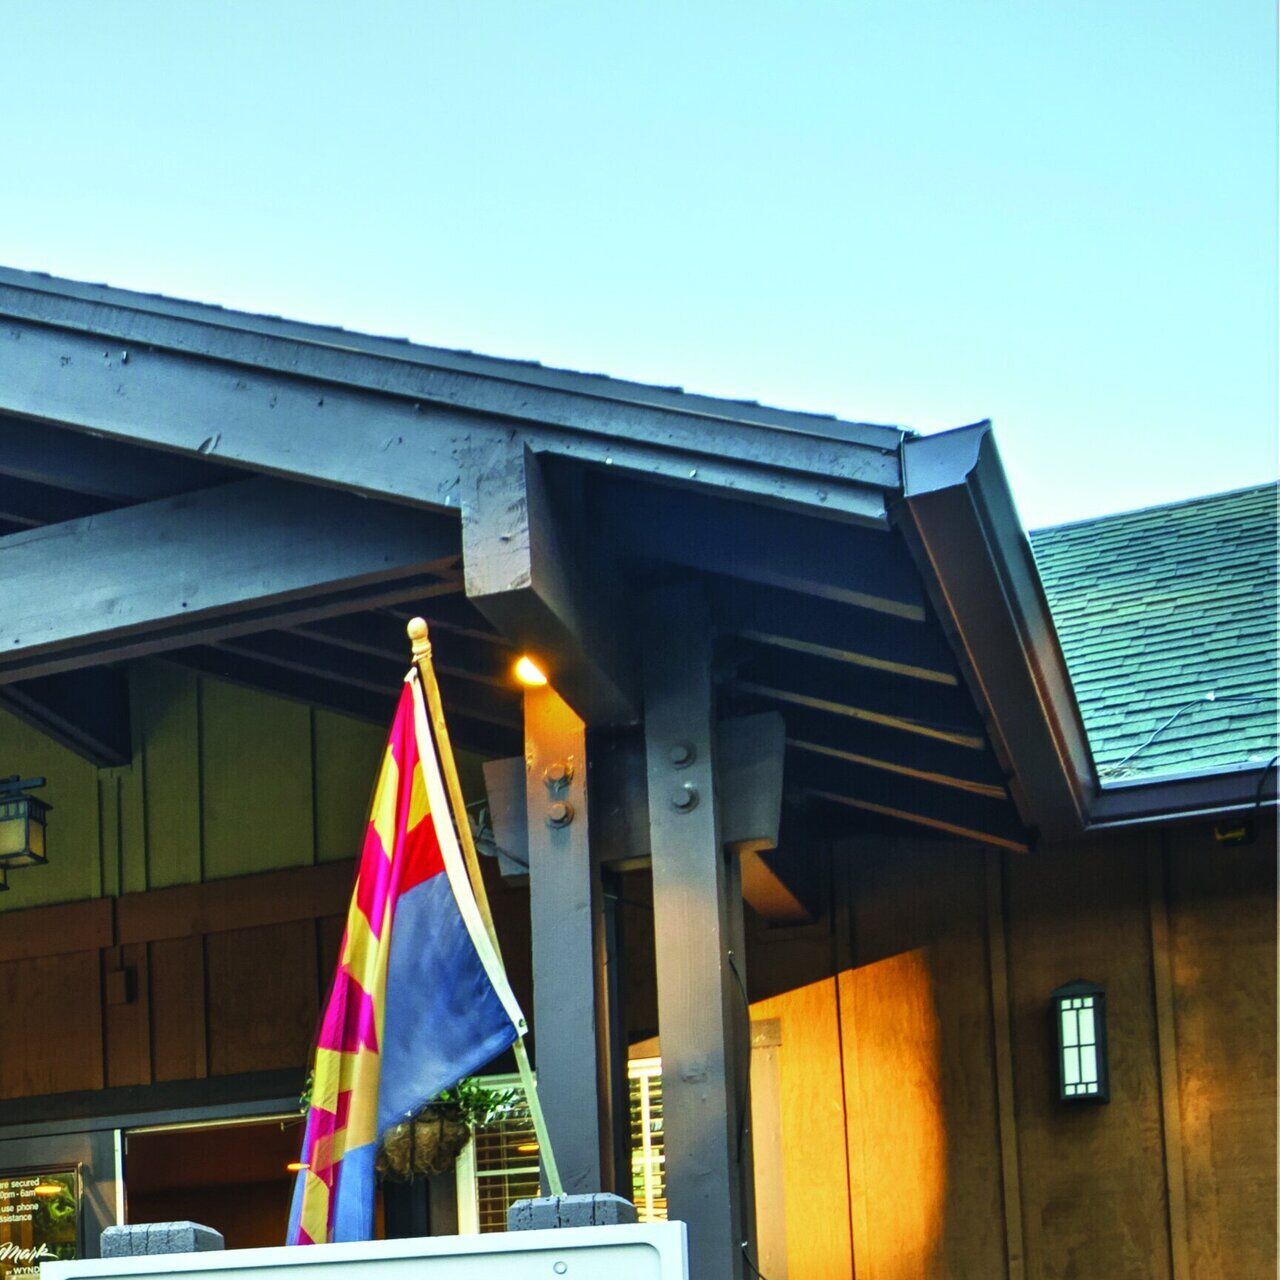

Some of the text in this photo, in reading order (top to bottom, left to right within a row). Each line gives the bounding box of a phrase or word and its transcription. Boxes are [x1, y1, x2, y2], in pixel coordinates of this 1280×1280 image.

[11, 1178, 40, 1188] secured
[20, 1189, 36, 1197] 6am
[17, 1203, 39, 1213] phone
[13, 1266, 40, 1274] WYND
